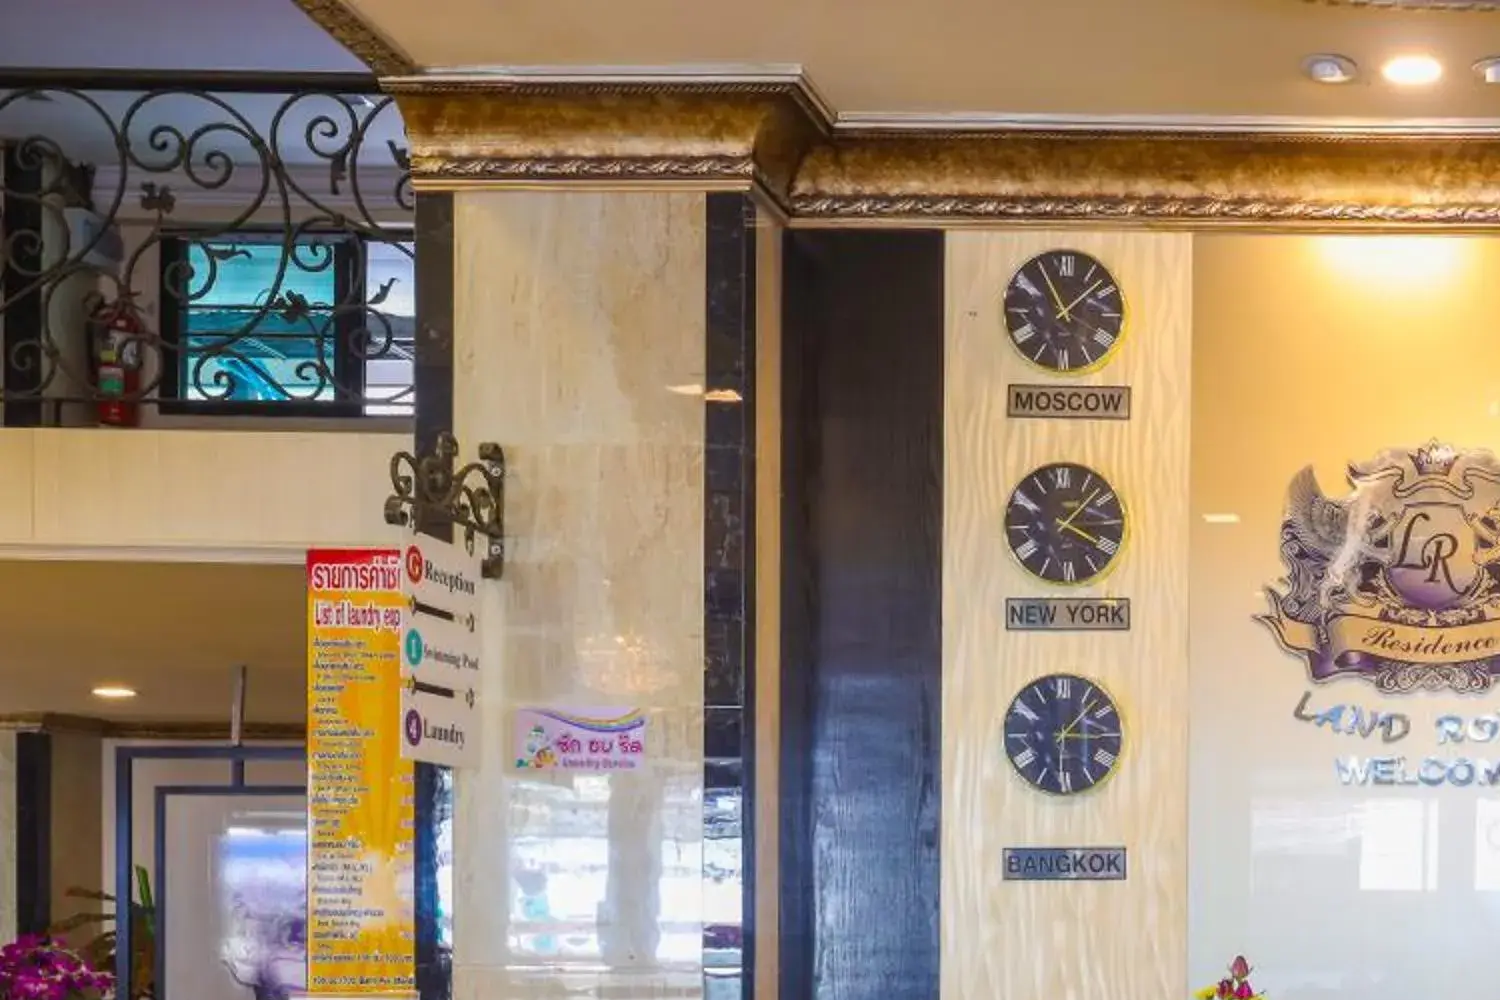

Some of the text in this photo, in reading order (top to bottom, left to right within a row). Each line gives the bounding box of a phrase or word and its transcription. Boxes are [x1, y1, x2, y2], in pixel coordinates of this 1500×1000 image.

[1014, 391, 1122, 413] MOSCOW
[313, 555, 400, 590] รายการค่าซั
[424, 559, 475, 596] Reception
[1010, 605, 1124, 624] NEW YORK
[1361, 626, 1498, 655] Residence
[1293, 691, 1411, 744] LAND
[423, 717, 465, 749] Laundry
[1007, 854, 1121, 874] BANGKOK
